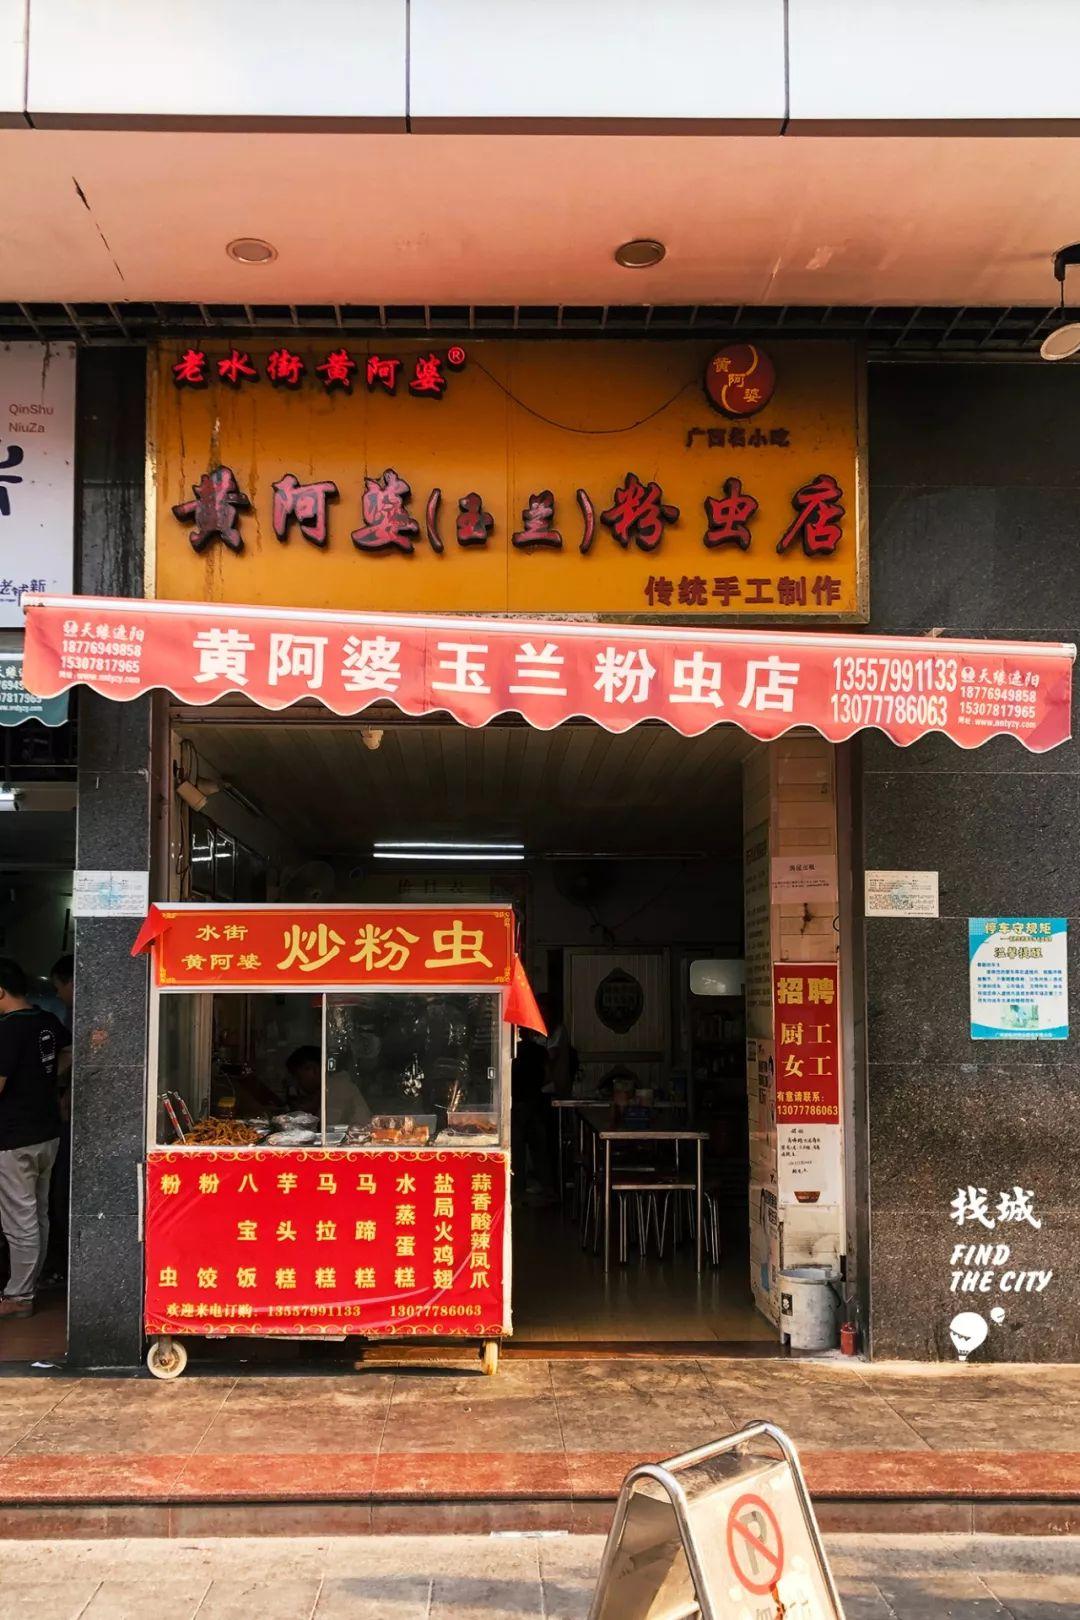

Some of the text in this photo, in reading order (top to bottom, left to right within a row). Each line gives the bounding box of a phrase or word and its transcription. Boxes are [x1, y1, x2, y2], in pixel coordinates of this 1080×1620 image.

[174, 349, 445, 392] 老水街黄阿婆
[9, 404, 54, 416] QinShu
[9, 423, 45, 434] NiuZa
[644, 575, 842, 606] 传统手工制作
[62, 640, 142, 657] 18776949858
[61, 655, 140, 673] 15307817965
[191, 626, 801, 714] 黄阿婆玉兰粉虫店
[832, 656, 958, 693] 13557991133
[960, 686, 1037, 703] 18776949858
[831, 693, 948, 727] 13077786063
[960, 702, 1036, 719] 15307817965
[195, 924, 248, 942] 水街
[277, 920, 493, 972] 炒粉虫
[181, 953, 262, 971] 黄阿婆
[777, 977, 835, 1005] 招聘
[780, 1023, 832, 1046] 厨工
[783, 1055, 833, 1078] 女工
[777, 1105, 839, 1116] 13077786063
[237, 1173, 259, 1288] 八宝饭
[275, 1173, 298, 1288] 芋头糕
[315, 1173, 337, 1288] 马拉糕
[354, 1173, 377, 1288] 马蹄糕
[394, 1173, 416, 1288] 水蒸蛋糕
[470, 1173, 492, 1289] 蒜香酸辣凤爪
[268, 1305, 361, 1317] 13557991133
[390, 1305, 482, 1317] 13077786063
